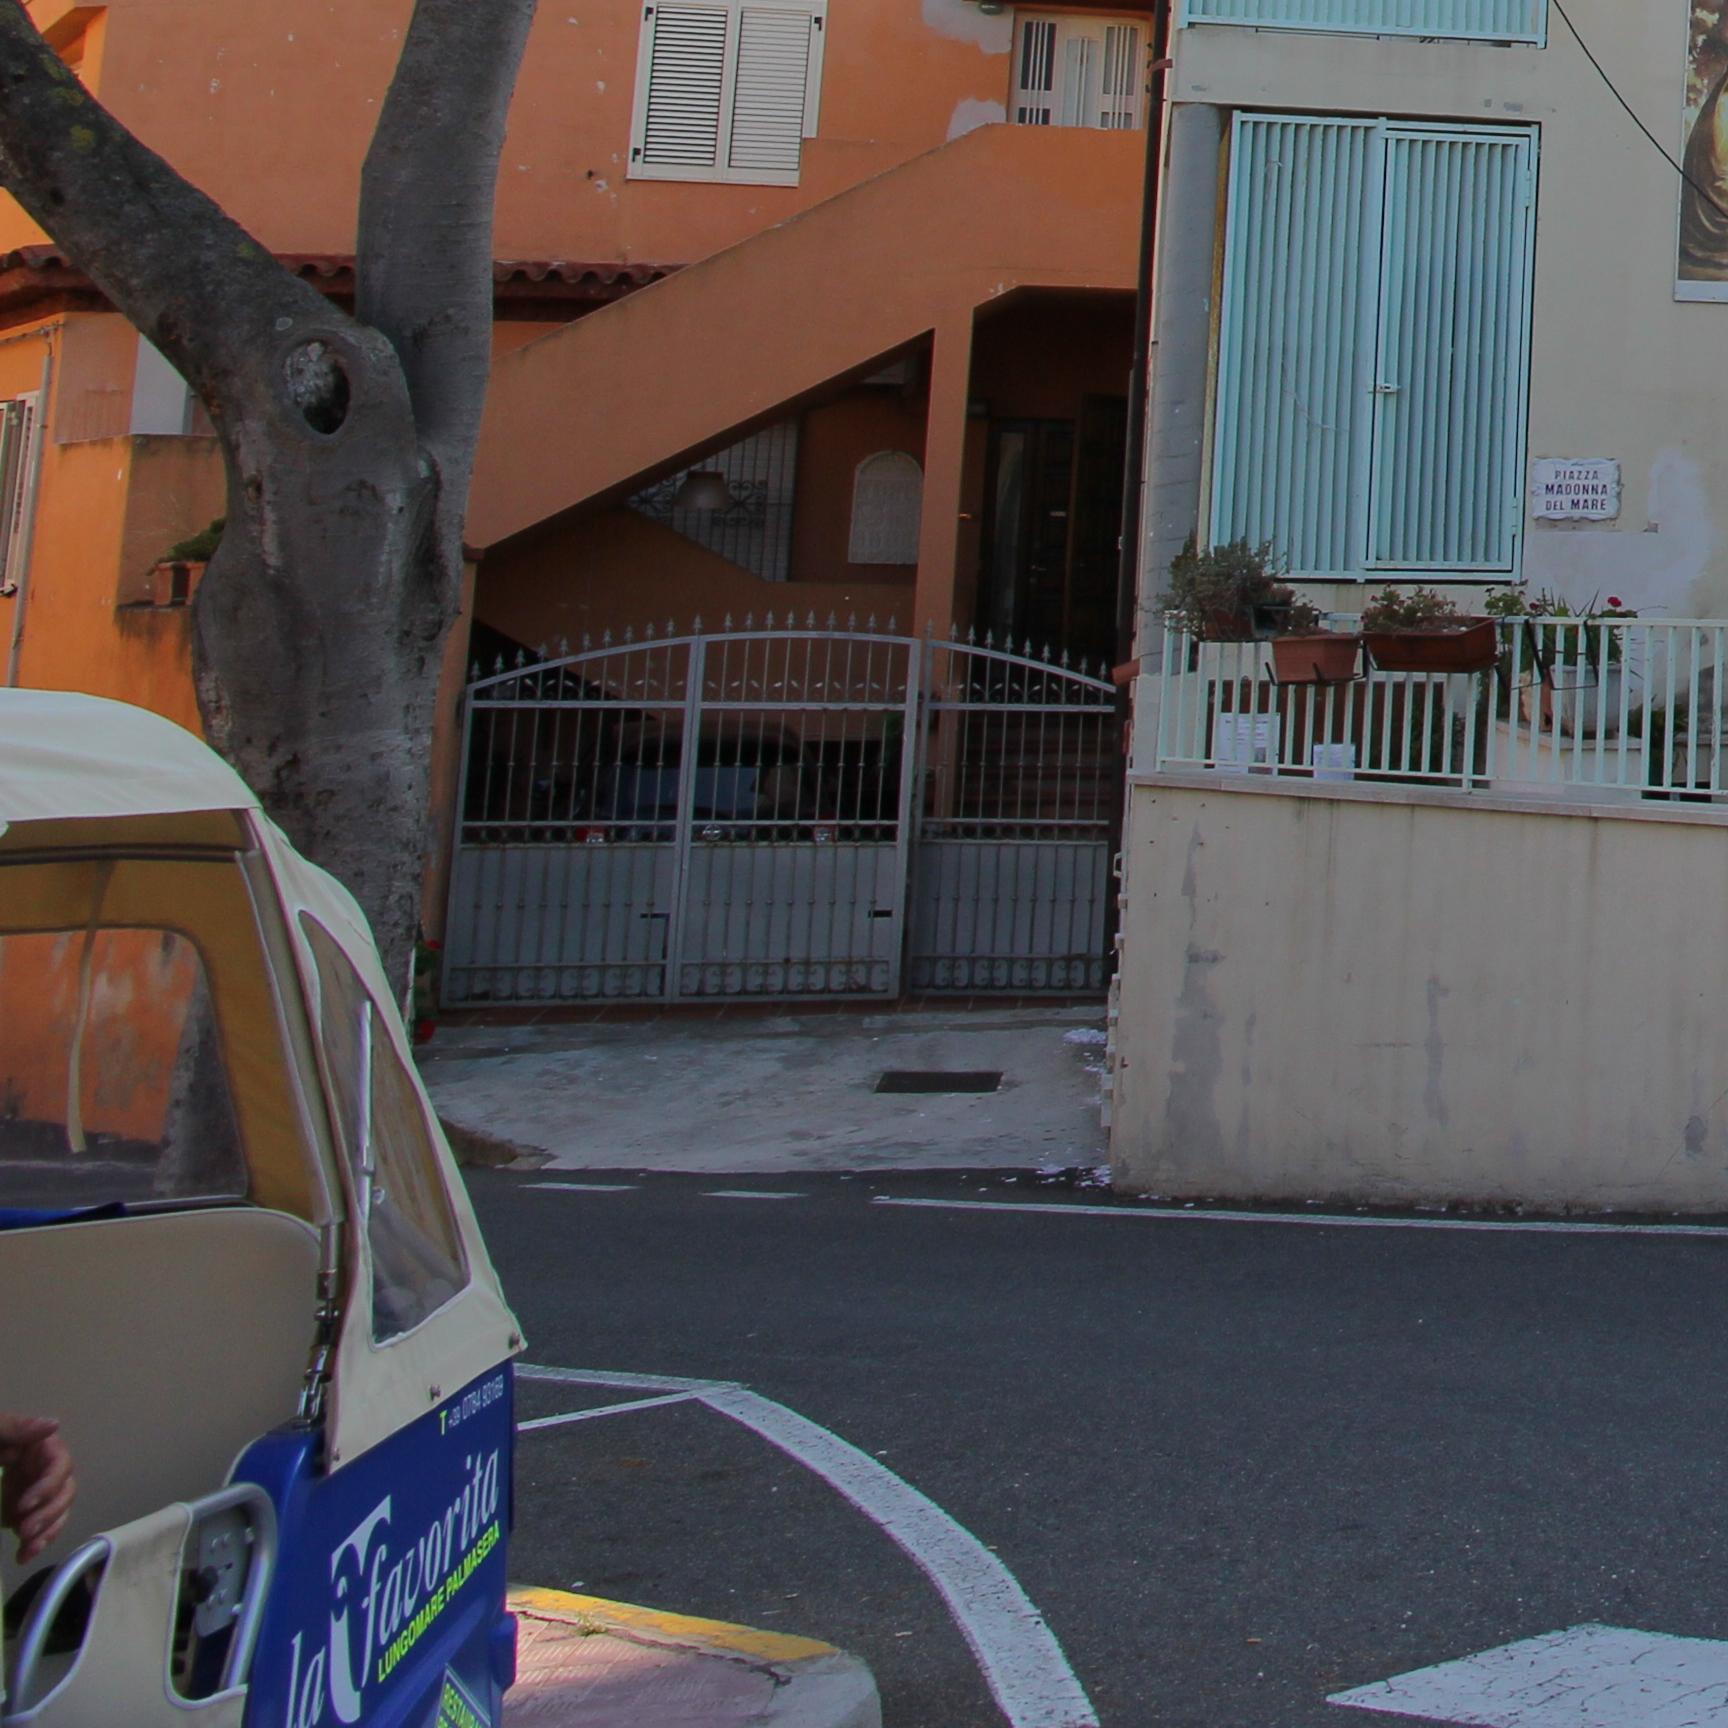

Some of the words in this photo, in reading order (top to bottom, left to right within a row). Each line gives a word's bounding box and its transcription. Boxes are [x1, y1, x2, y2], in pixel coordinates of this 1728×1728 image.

[1554, 470, 1599, 481] PIAZZA
[1545, 483, 1609, 496] MADONNA
[1545, 500, 1565, 511] DEL
[1570, 498, 1607, 511] MARE
[440, 1409, 448, 1436] T
[378, 1585, 445, 1684] LUNGOMARE
[445, 1519, 500, 1602] PALMASERA
